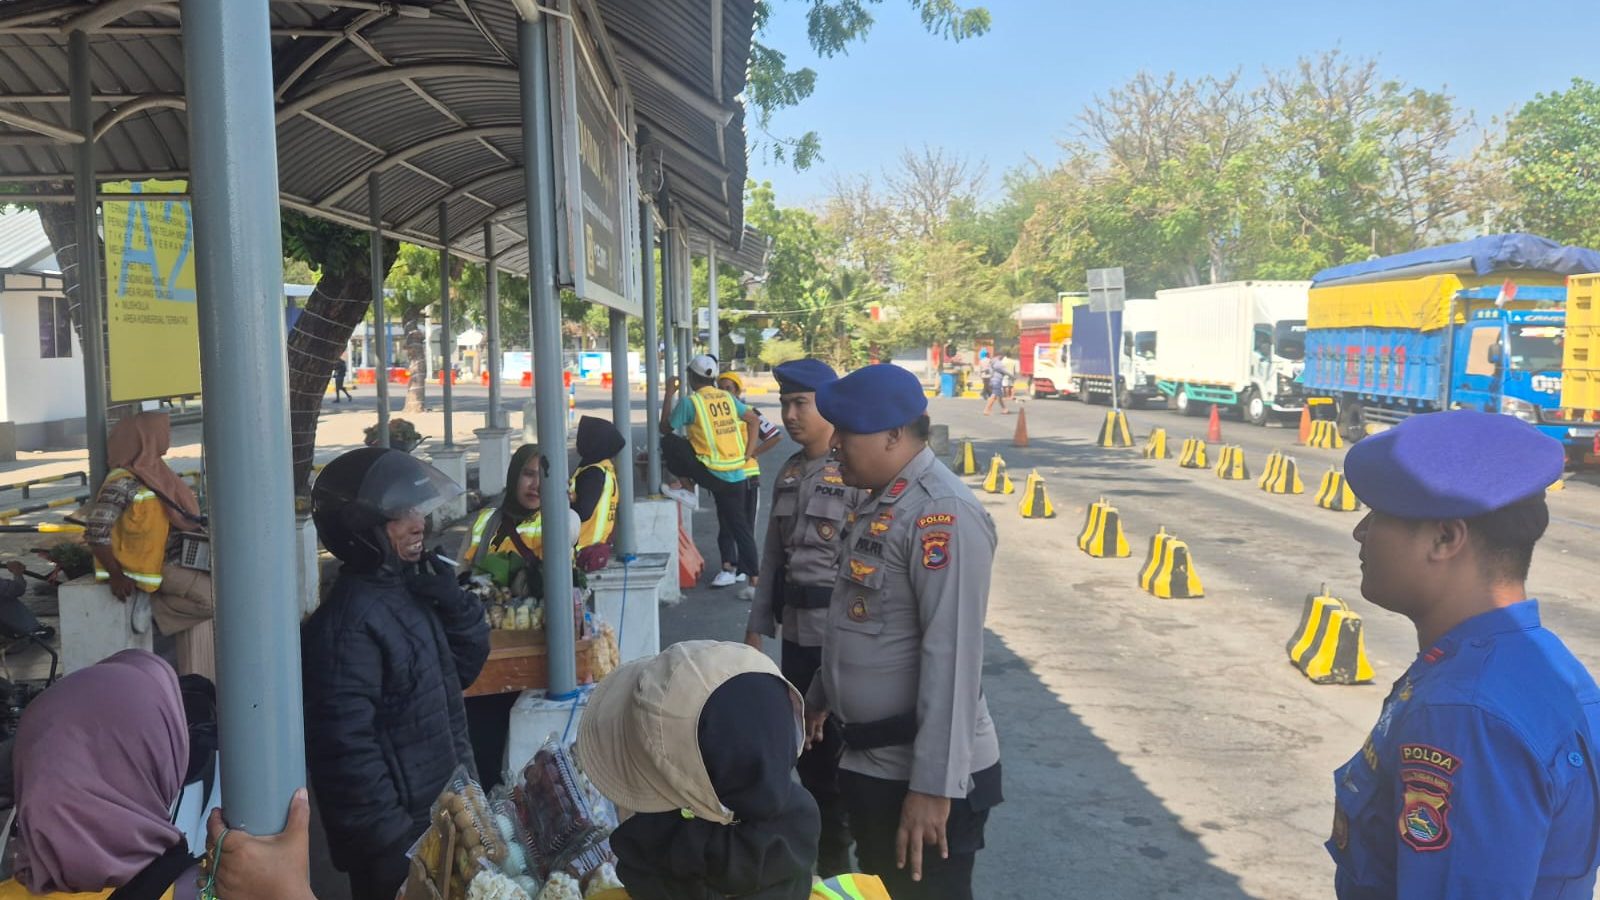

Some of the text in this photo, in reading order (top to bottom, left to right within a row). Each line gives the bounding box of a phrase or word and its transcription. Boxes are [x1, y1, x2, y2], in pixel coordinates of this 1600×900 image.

[709, 401, 731, 417] 019
[815, 484, 845, 498] POLRI
[920, 515, 951, 527] POLDA
[1403, 747, 1453, 769] POLDA
